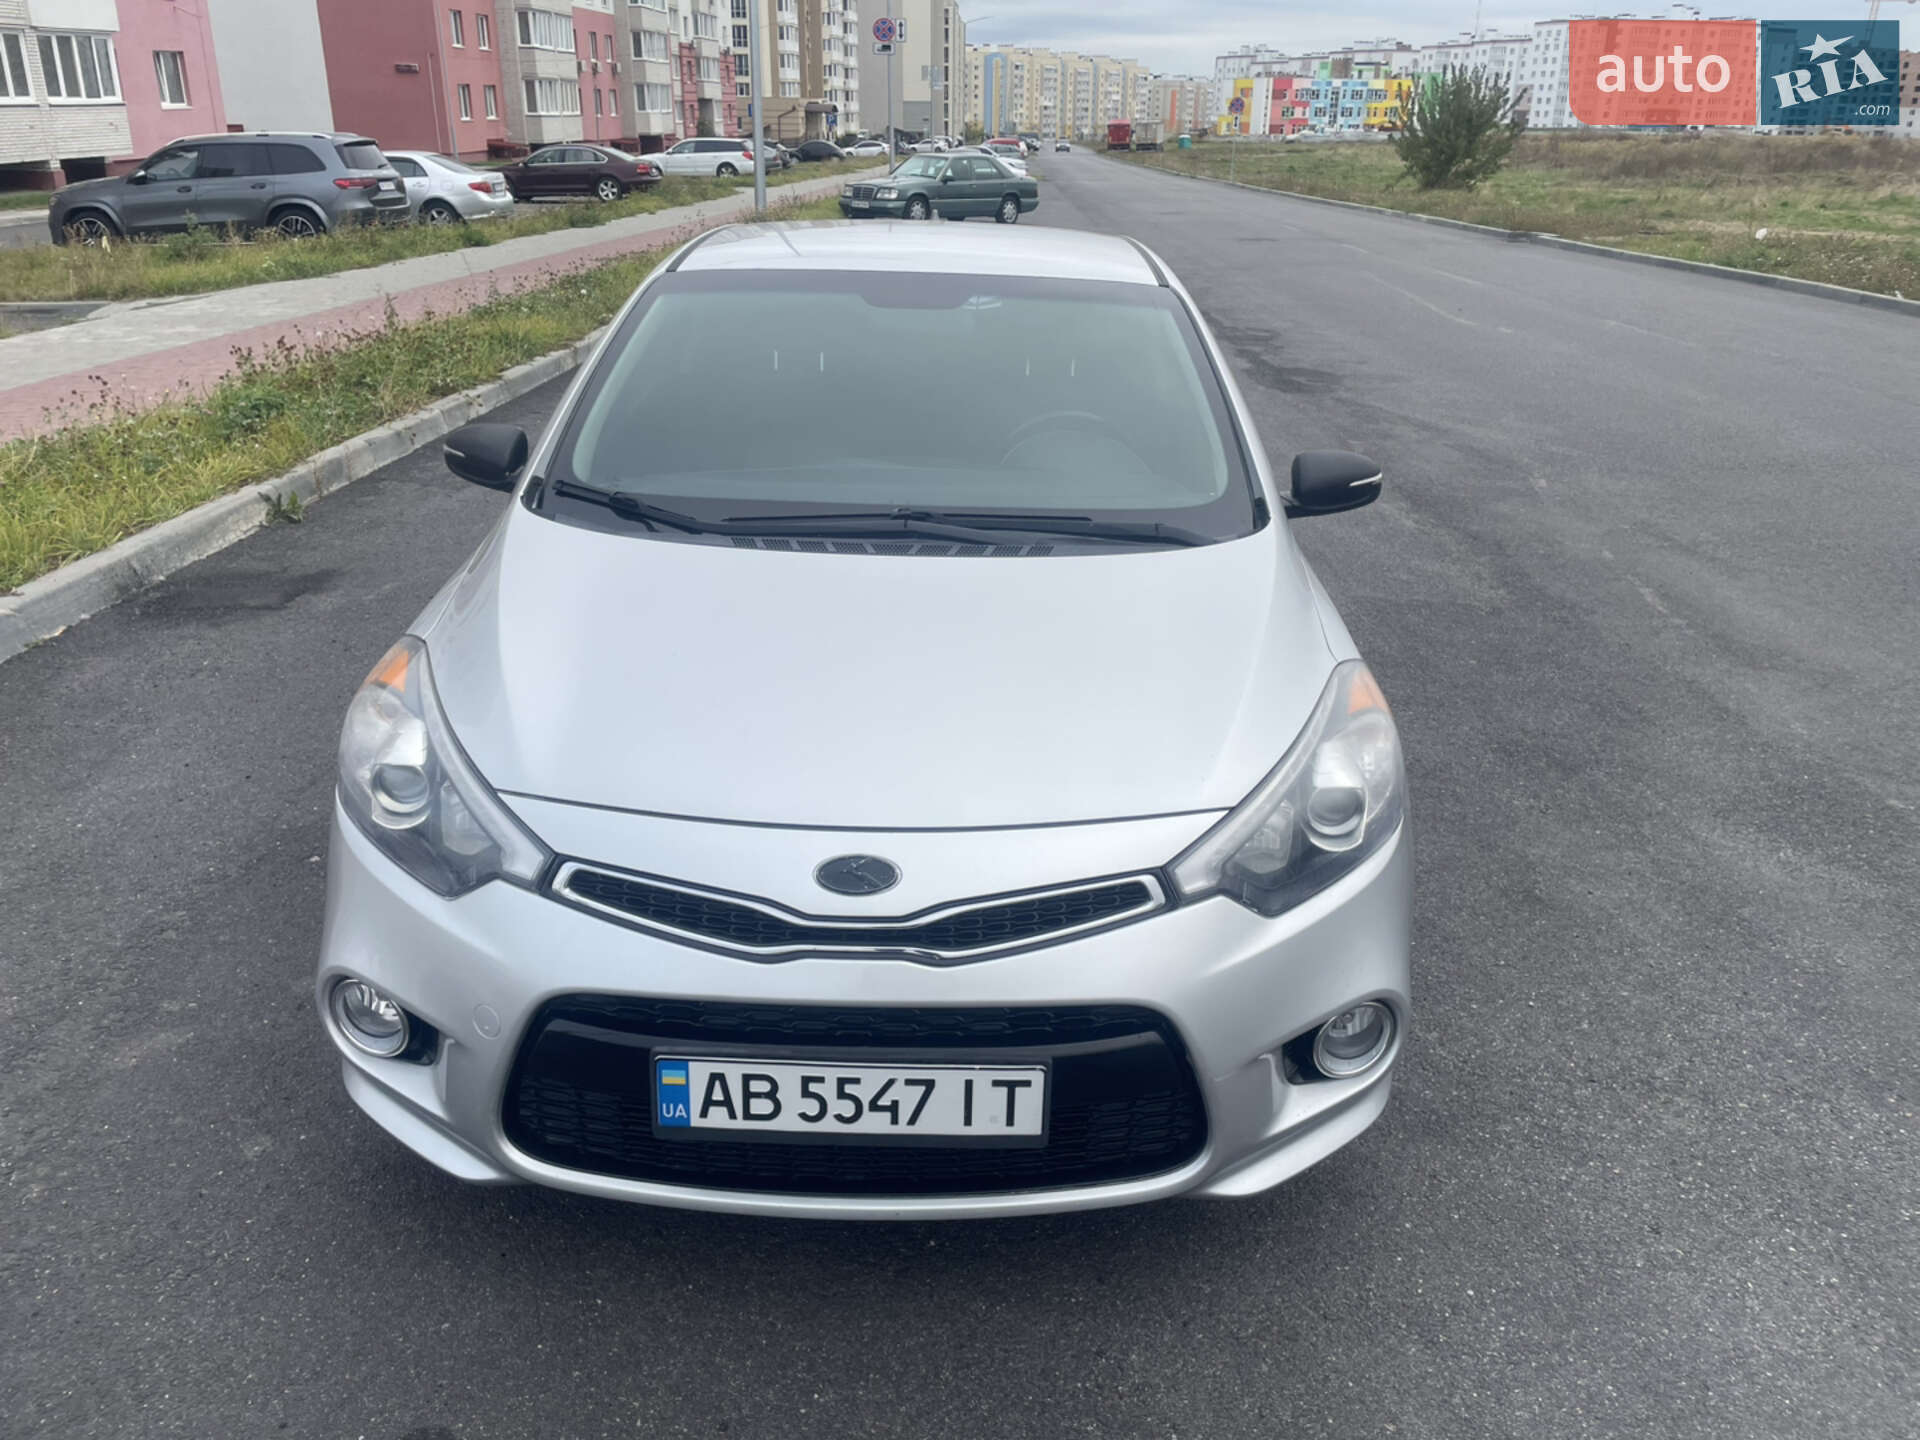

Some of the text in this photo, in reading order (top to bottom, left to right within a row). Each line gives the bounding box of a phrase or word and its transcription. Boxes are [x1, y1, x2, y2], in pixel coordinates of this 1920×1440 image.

[662, 1103, 688, 1118] UA
[698, 1071, 1032, 1127] AB 5547 IT
